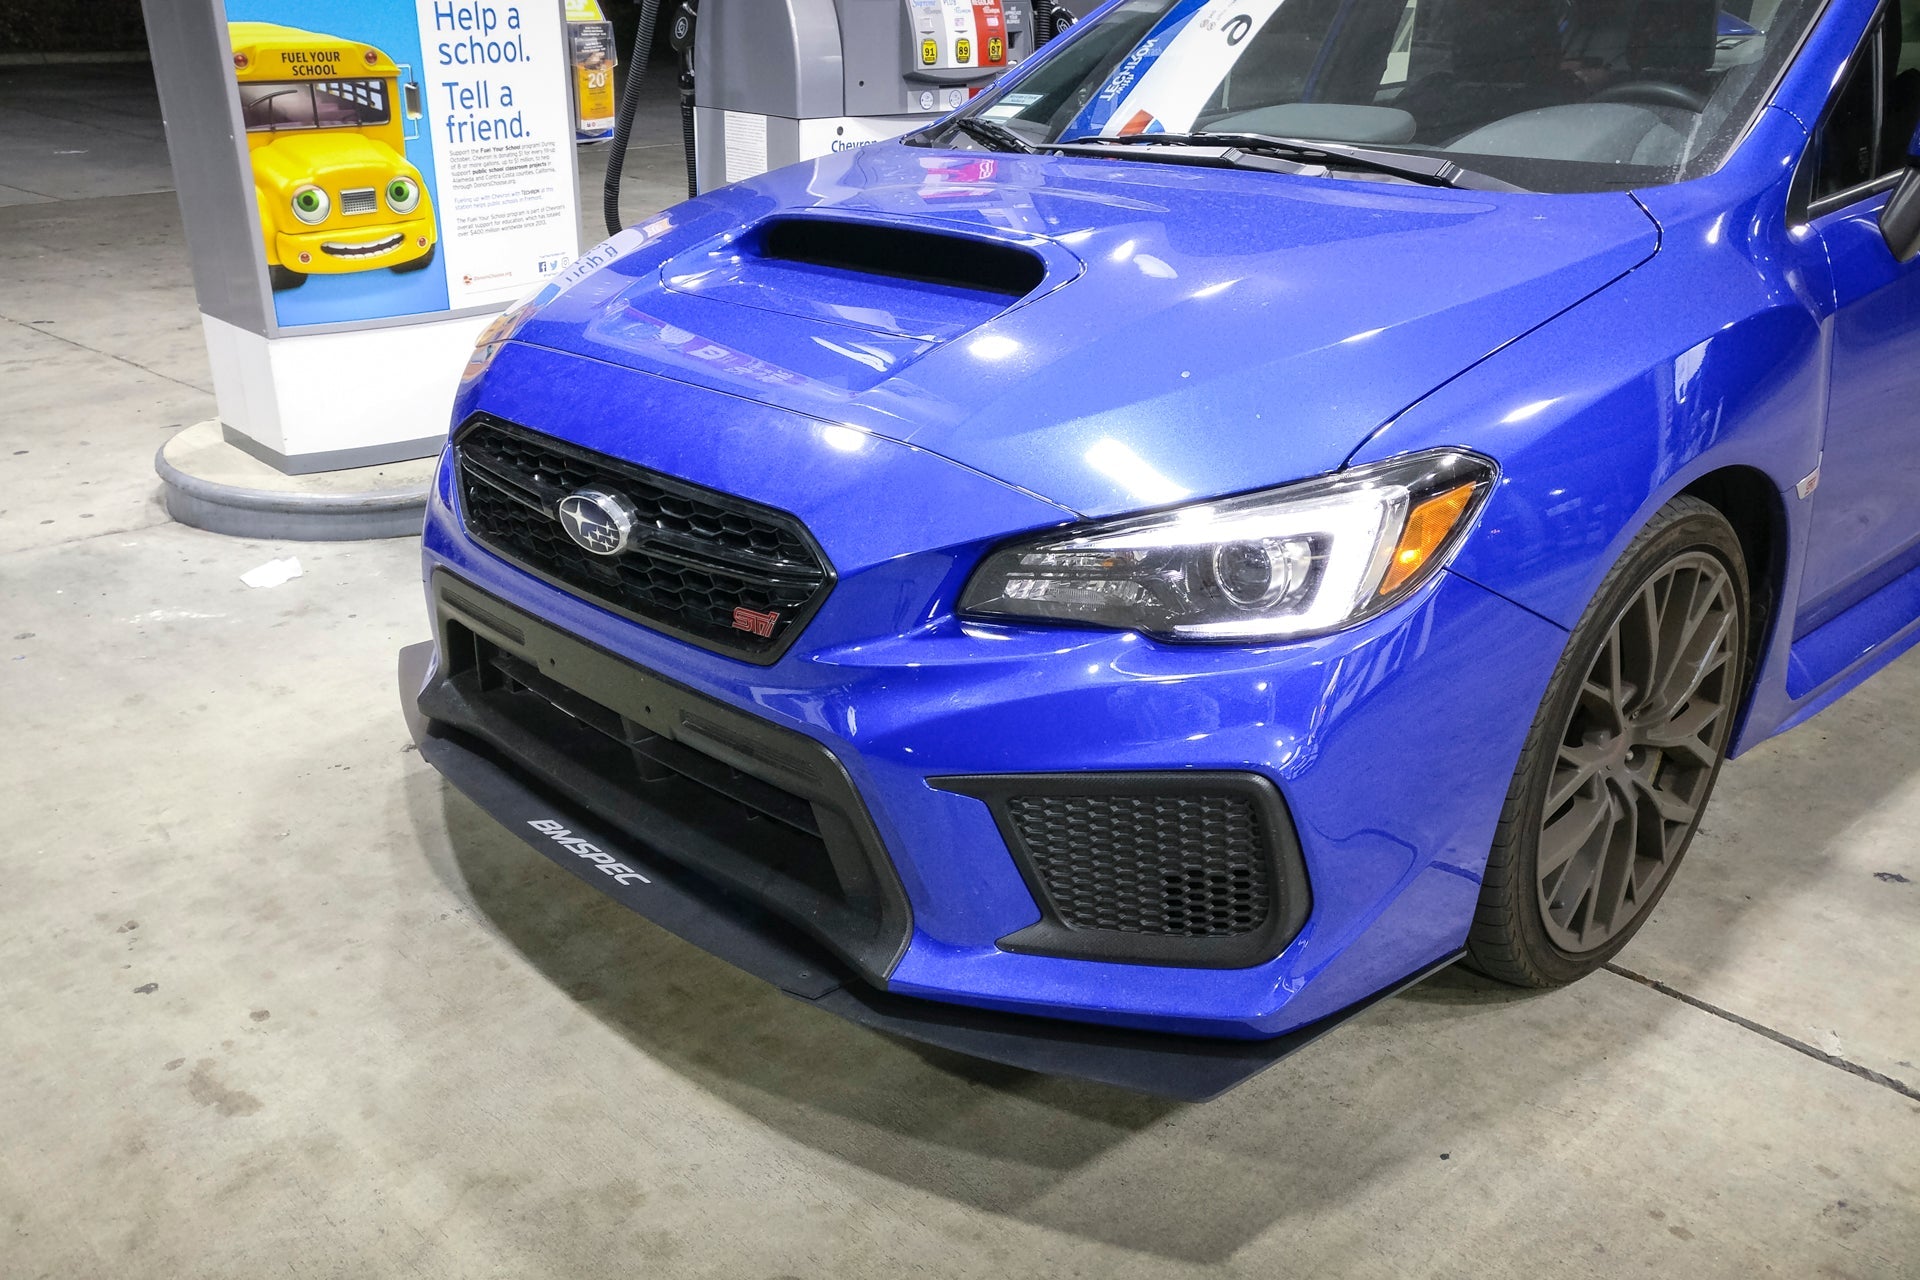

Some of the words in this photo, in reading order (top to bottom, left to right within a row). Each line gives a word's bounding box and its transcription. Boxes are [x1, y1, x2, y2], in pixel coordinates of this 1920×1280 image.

[434, 1, 496, 37] Help
[508, 8, 520, 29] a
[438, 34, 531, 66] school.
[924, 47, 935, 57] 91
[958, 46, 969, 56] 89
[990, 45, 1000, 54] 87
[281, 52, 308, 63] FUEL
[309, 51, 341, 63] YOUR
[292, 64, 337, 76] SCHOOL
[442, 80, 489, 110] Tell
[500, 85, 513, 107] a
[446, 110, 531, 143] friend.
[831, 140, 878, 153] Chevro
[527, 819, 652, 886] BMSPEC
